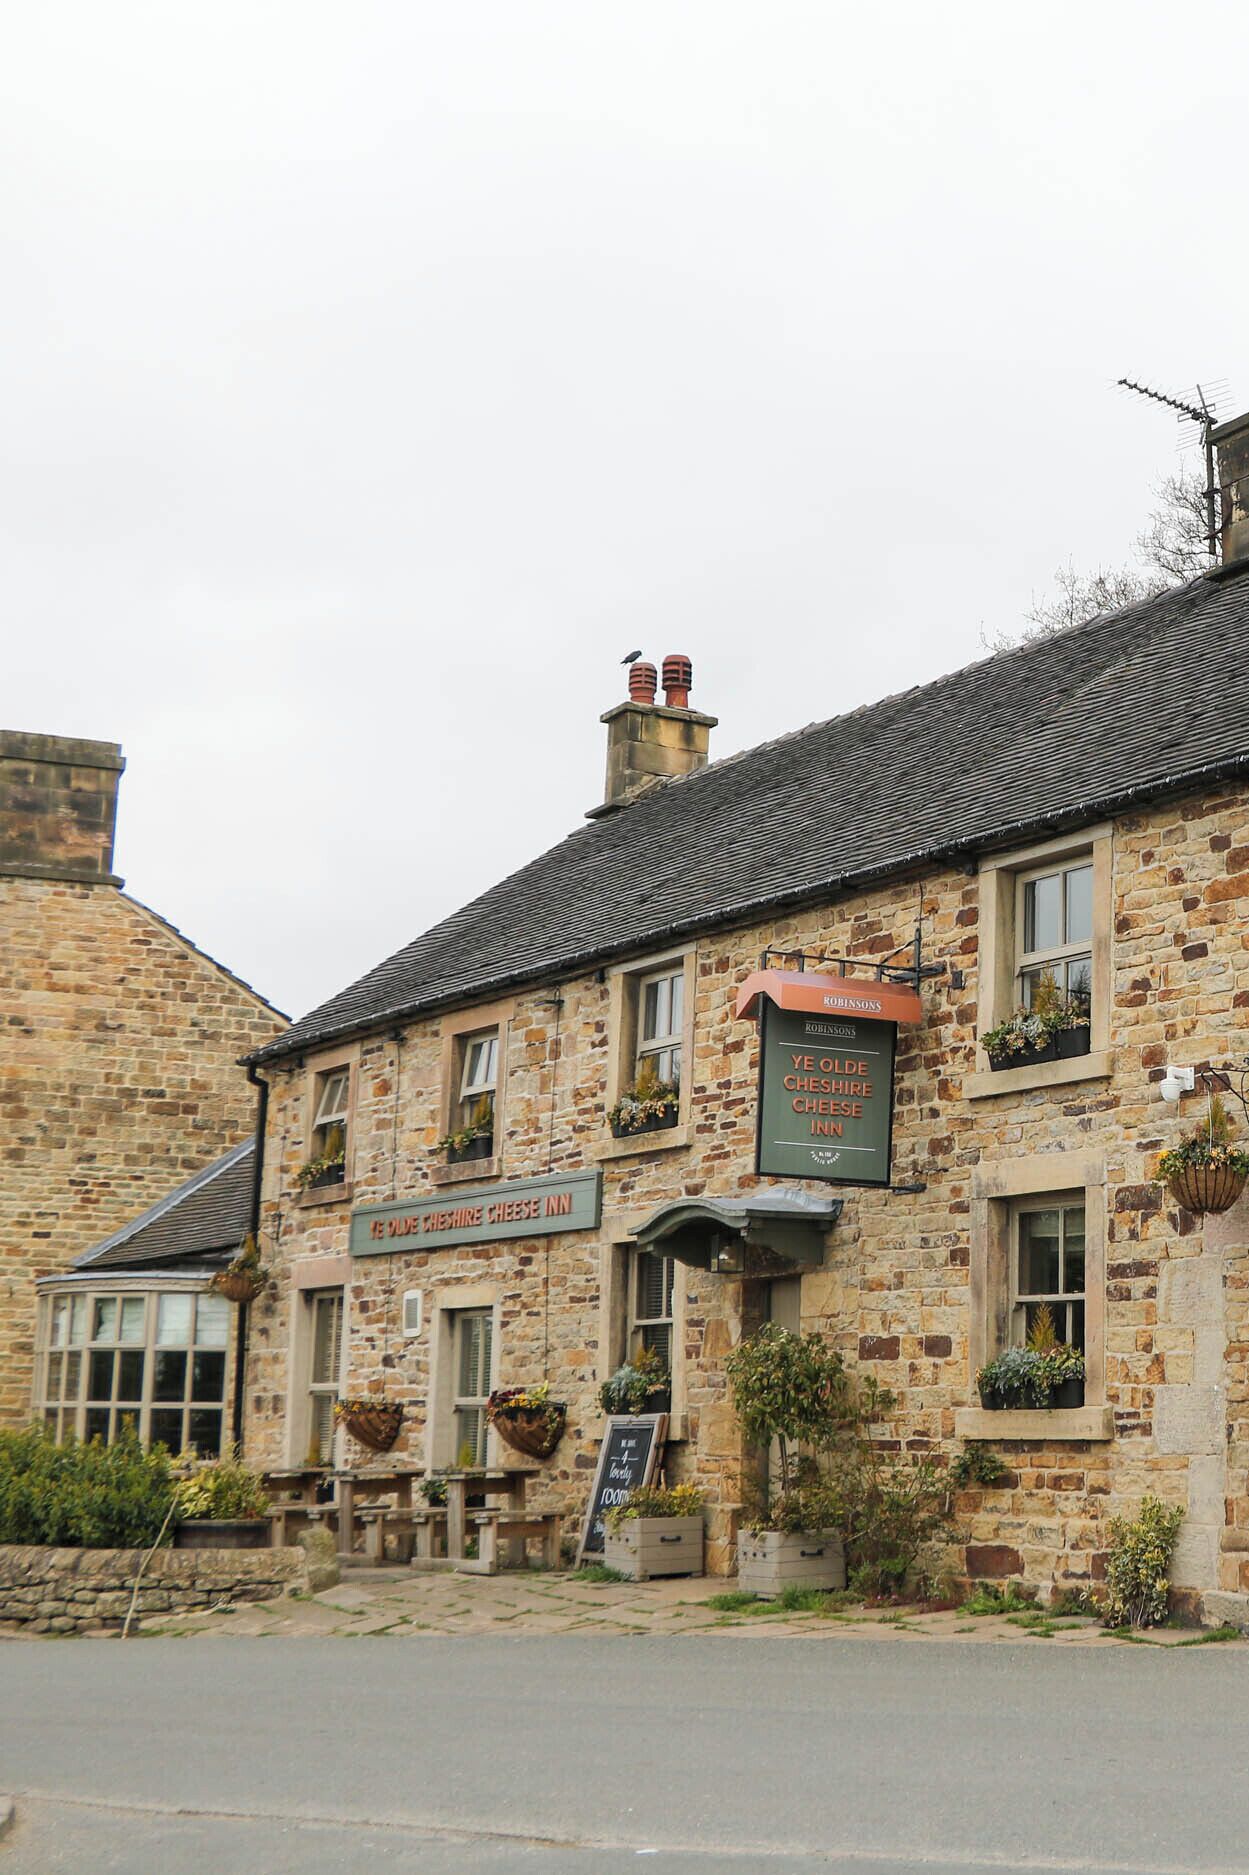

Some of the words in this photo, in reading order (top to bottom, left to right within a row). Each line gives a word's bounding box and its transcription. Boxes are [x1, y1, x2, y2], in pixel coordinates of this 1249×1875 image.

[823, 995, 881, 1011] ROBINSONS
[805, 1023, 856, 1036] ROBINSONS
[791, 1054, 815, 1072] YE
[820, 1058, 869, 1077] OLDE
[783, 1075, 873, 1098] CHESHIRE
[792, 1097, 863, 1118] CHEESE
[811, 1119, 844, 1137] INN
[370, 1220, 384, 1240] YE
[387, 1215, 419, 1237] OLDE
[422, 1206, 483, 1232] CHESHIRE
[487, 1197, 539, 1224] CHEESE
[544, 1192, 572, 1216] INN
[609, 1462, 632, 1487] lovely
